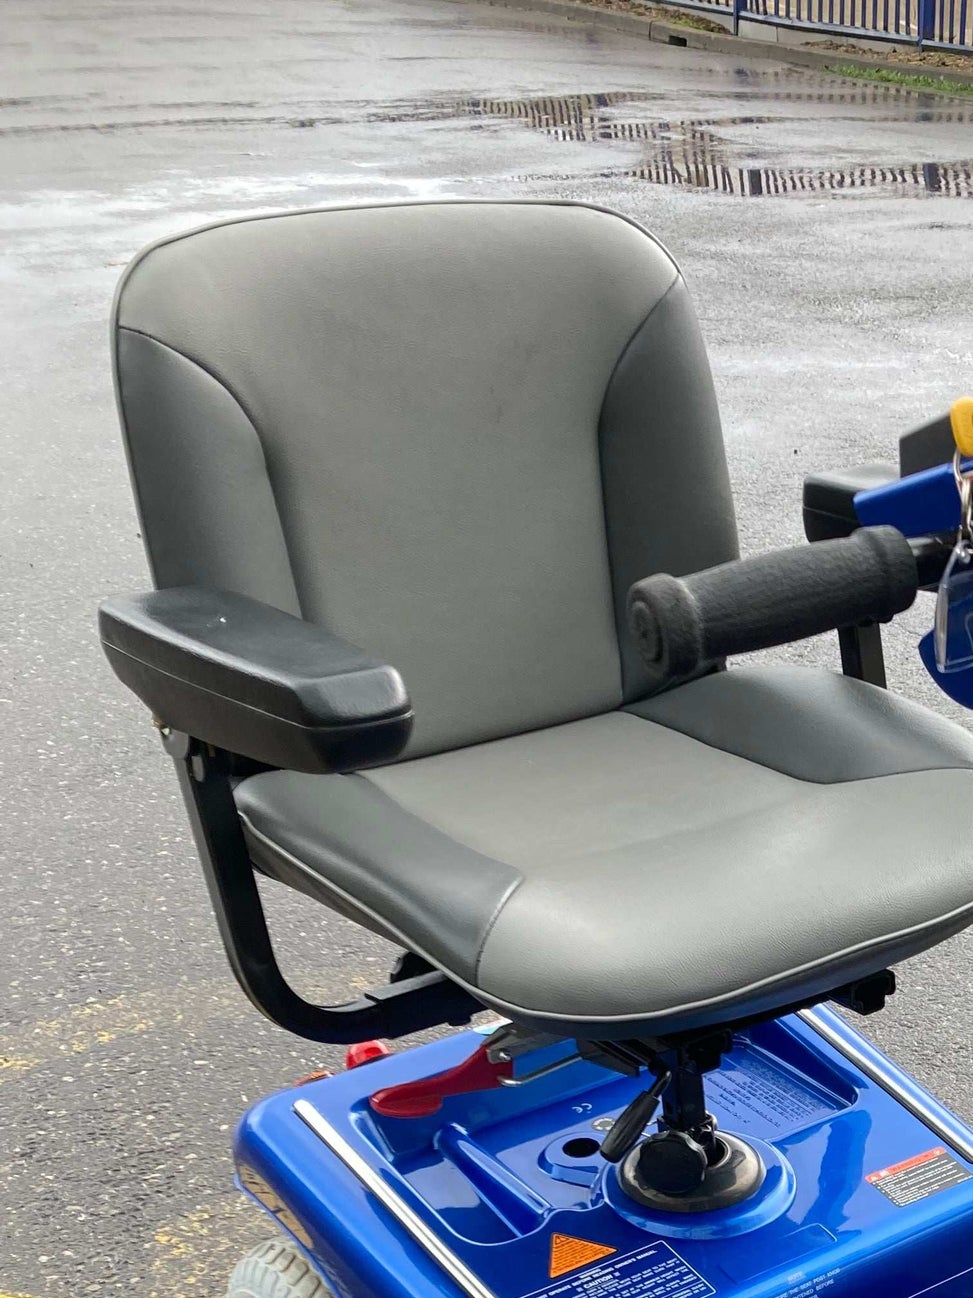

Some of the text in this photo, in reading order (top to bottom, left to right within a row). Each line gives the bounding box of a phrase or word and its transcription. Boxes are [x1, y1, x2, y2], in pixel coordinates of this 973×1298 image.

[584, 1274, 614, 1289] CAUTION
[813, 1275, 826, 1284] POST
[816, 1278, 834, 1291] BEFORE
